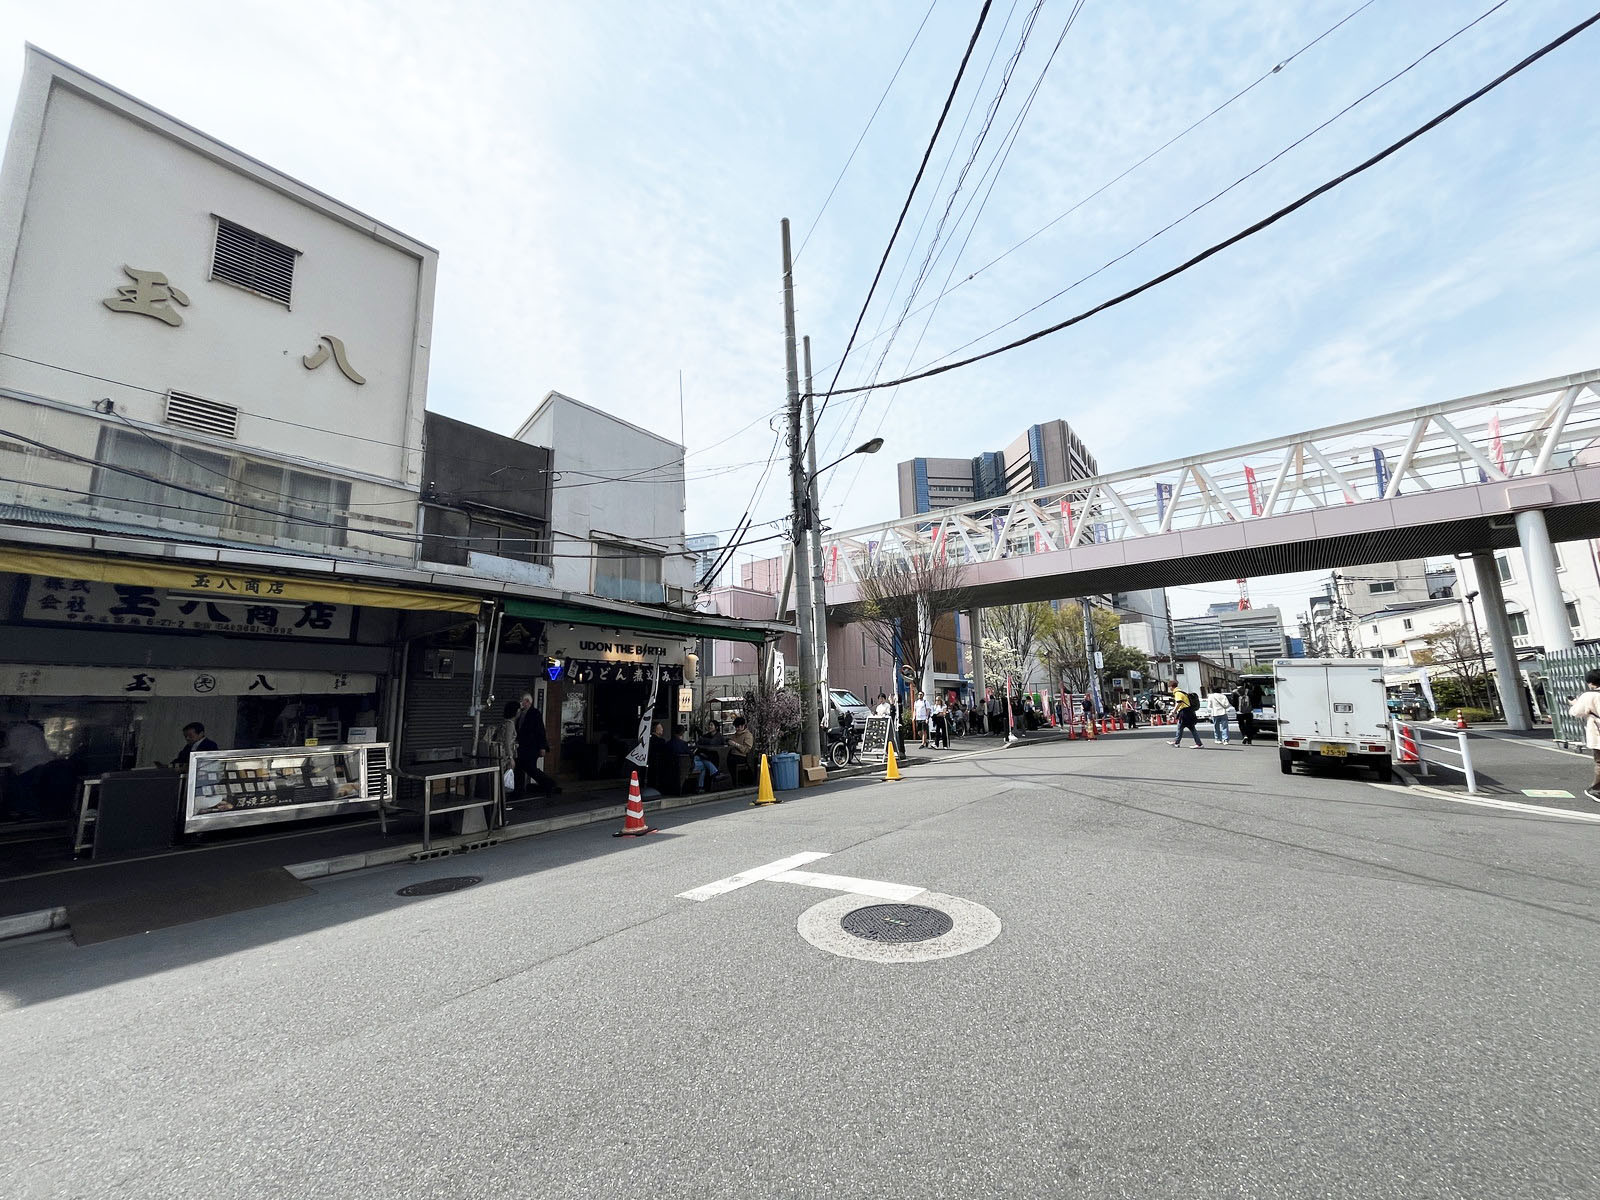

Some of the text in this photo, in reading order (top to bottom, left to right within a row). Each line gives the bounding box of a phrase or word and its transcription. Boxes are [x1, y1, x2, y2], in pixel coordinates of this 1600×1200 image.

[191, 574, 285, 595] 玉八商店
[580, 641, 612, 653] UDON
[614, 643, 635, 654] THE
